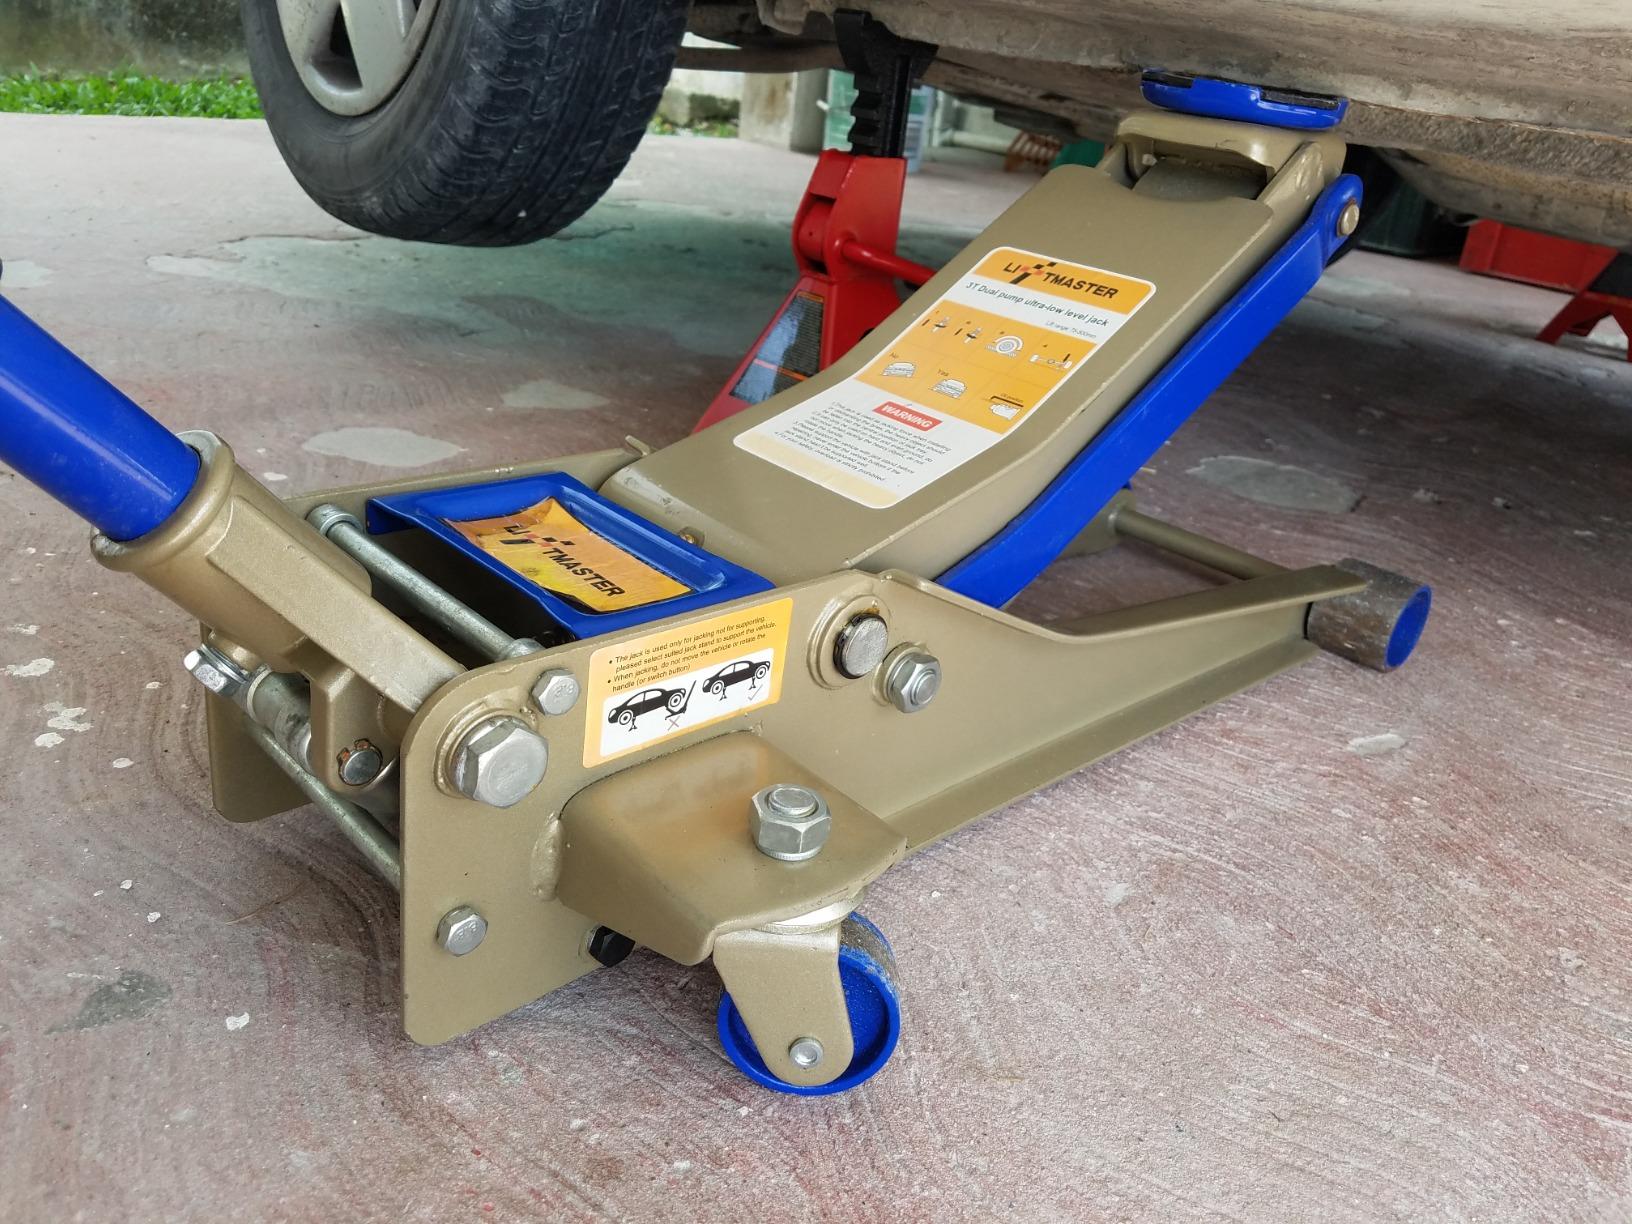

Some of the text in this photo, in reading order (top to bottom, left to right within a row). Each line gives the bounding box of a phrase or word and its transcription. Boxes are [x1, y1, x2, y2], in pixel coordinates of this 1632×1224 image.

[966, 281, 1110, 327] 3T Dual pump ultra-low level jack
[881, 404, 933, 428] WARNING
[614, 672, 633, 682] When
[660, 660, 670, 668] do
[671, 658, 681, 666] not
[681, 653, 699, 663] move
[711, 642, 732, 655] vehicle
[739, 637, 756, 647] rotate
[757, 633, 766, 641] the
[615, 660, 642, 674] pleased
[643, 652, 663, 665] select
[683, 644, 697, 655] jack
[698, 638, 715, 649] stand
[723, 631, 745, 643] support
[629, 651, 643, 661] jack
[652, 643, 668, 654] used
[669, 640, 683, 651] only
[683, 637, 692, 645] for
[692, 631, 715, 643] jacking
[726, 624, 735, 632] for
[612, 664, 691, 692] handle (or switch button)
